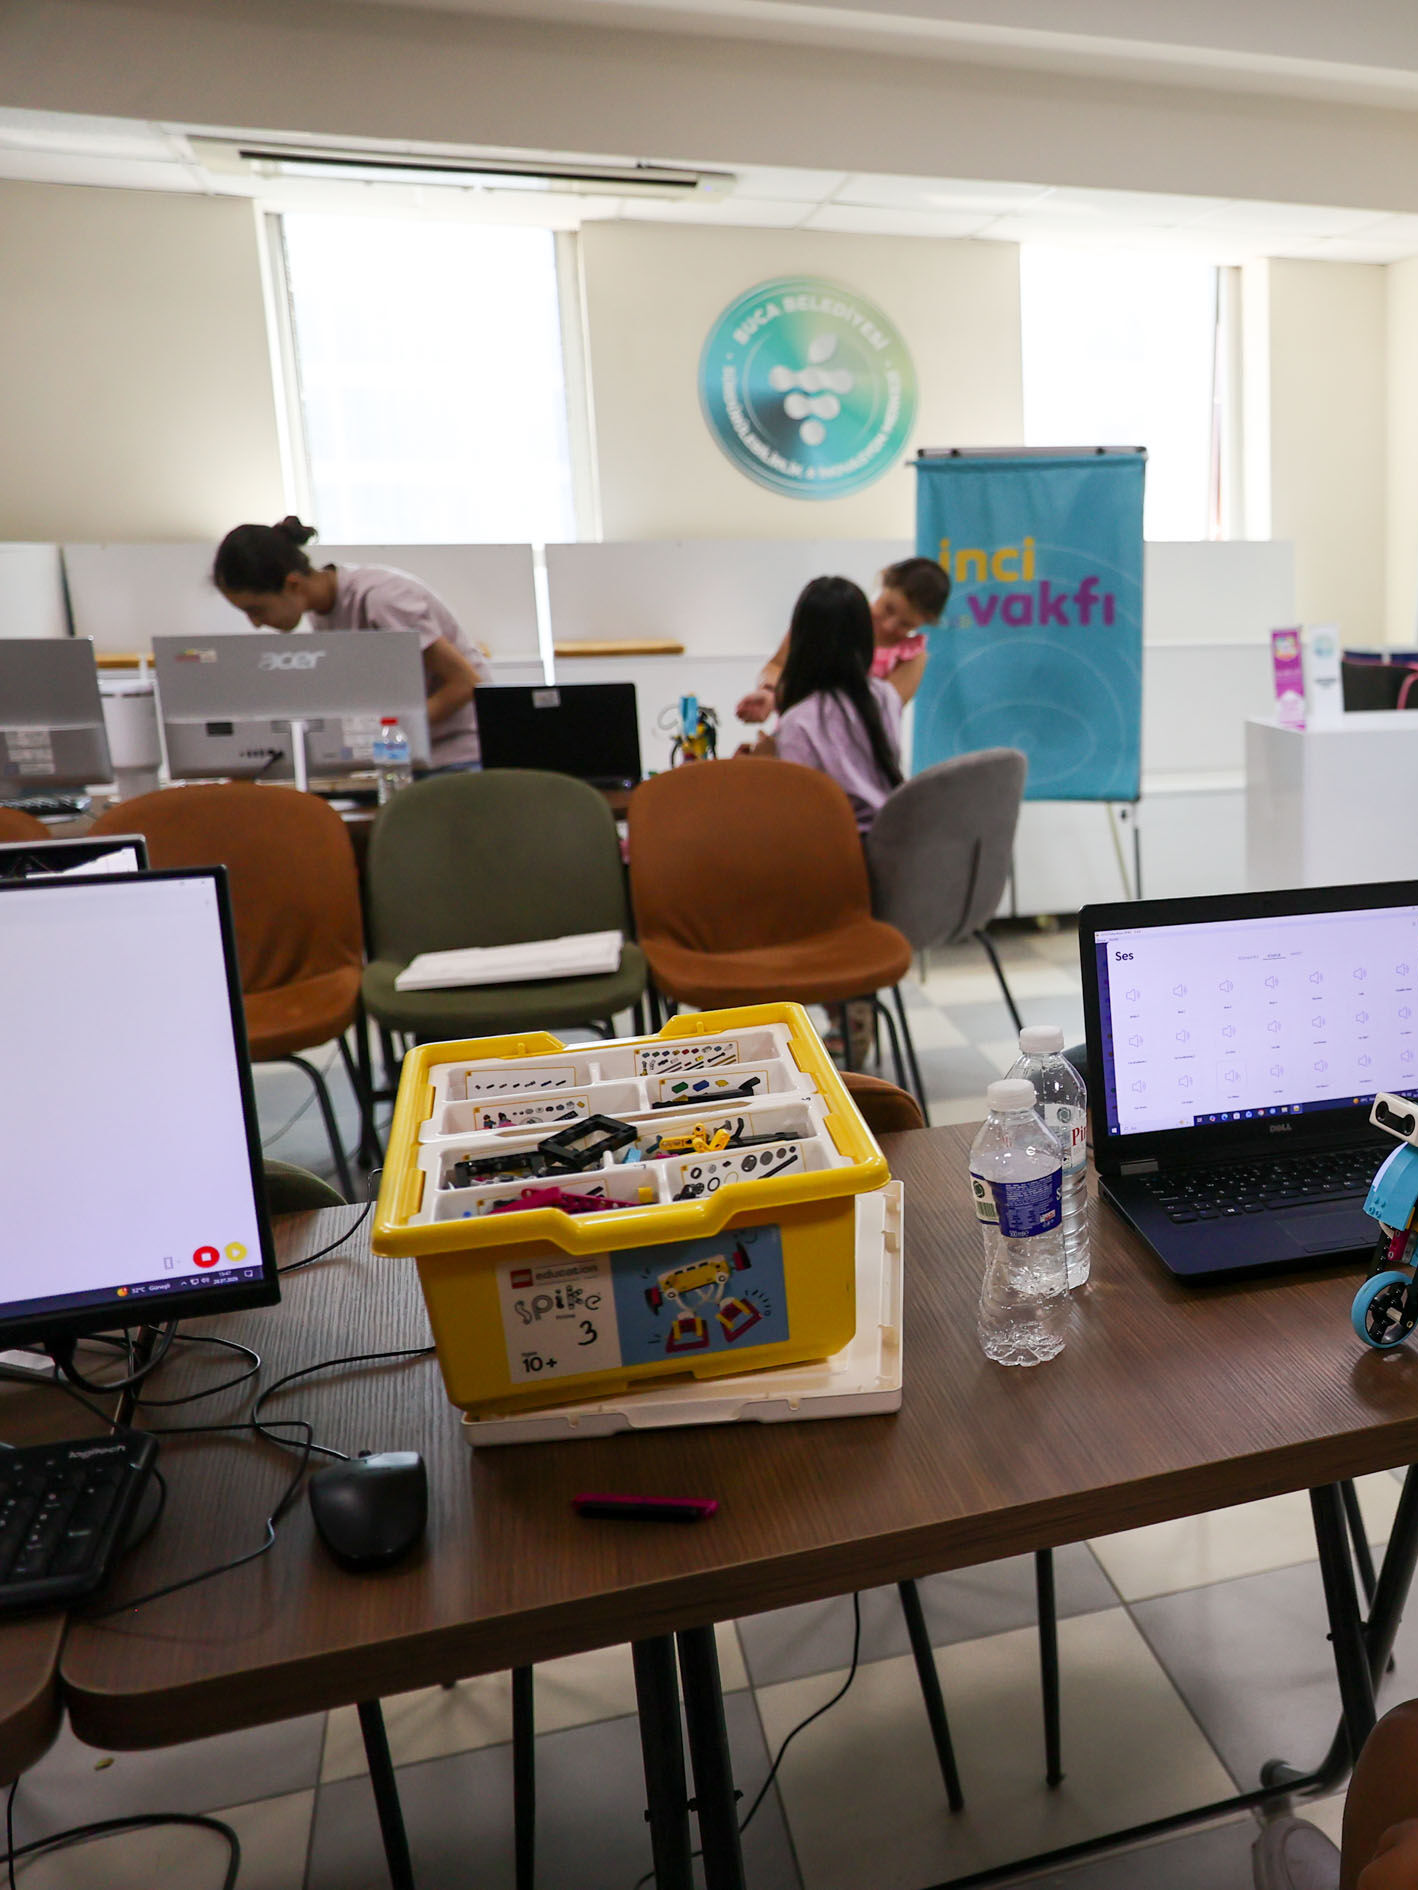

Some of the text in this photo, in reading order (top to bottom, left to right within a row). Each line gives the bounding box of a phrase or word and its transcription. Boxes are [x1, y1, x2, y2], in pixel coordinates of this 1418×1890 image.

[733, 302, 781, 345] BUCA
[938, 536, 1036, 583] inci
[966, 576, 1116, 628] vakfı
[1115, 951, 1134, 962] Ses
[577, 1320, 598, 1346] 3
[522, 1356, 558, 1373] 10+
